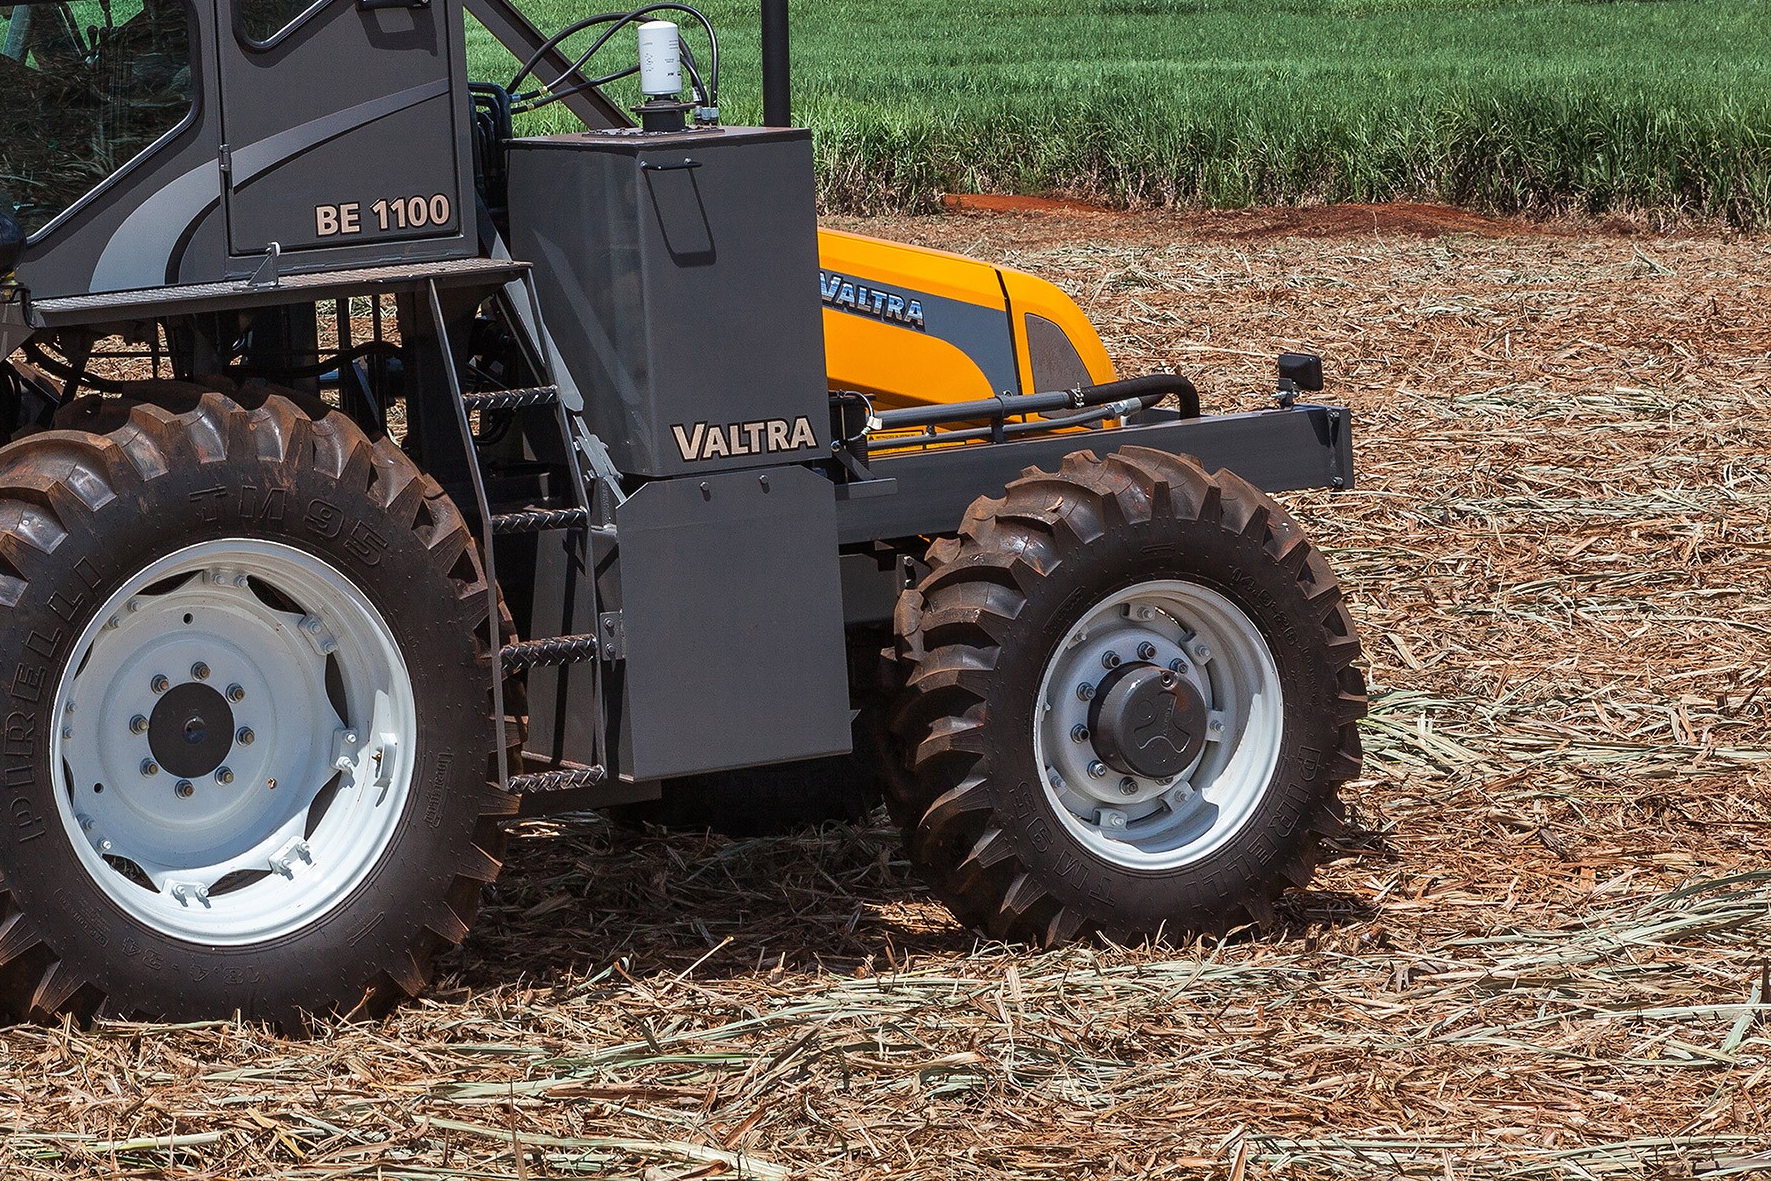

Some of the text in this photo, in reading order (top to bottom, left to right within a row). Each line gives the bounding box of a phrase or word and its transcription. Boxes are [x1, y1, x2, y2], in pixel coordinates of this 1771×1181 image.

[315, 193, 450, 237] BE 1100
[819, 271, 925, 328] VALTRA
[671, 416, 818, 461] VALTRA
[188, 483, 389, 566] TM 95
[3, 555, 103, 843] PIRELLI
[1183, 745, 1322, 909] PIRELLI
[1052, 849, 1116, 908] TM
